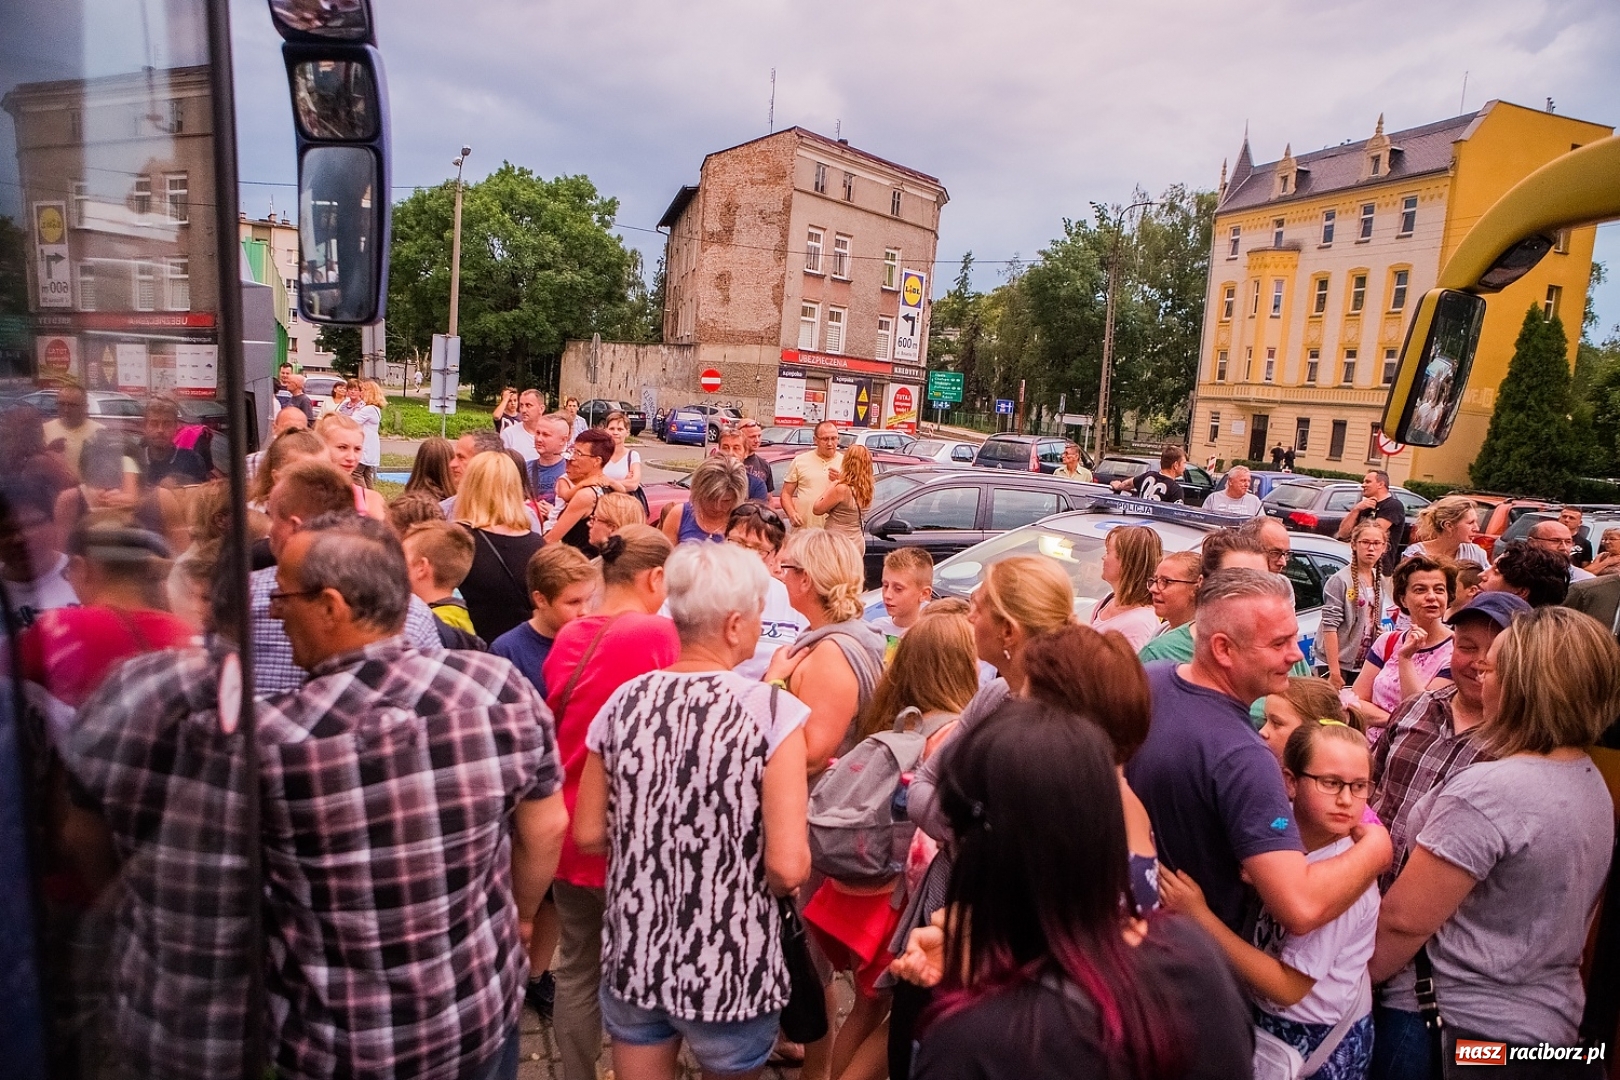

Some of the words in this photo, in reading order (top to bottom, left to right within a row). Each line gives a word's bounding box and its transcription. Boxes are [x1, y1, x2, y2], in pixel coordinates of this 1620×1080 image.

[897, 336, 912, 349] 600
[798, 352, 848, 367] UBEZPIECZENIA
[1117, 502, 1152, 514] POLICJA
[1270, 817, 1289, 830] 4F
